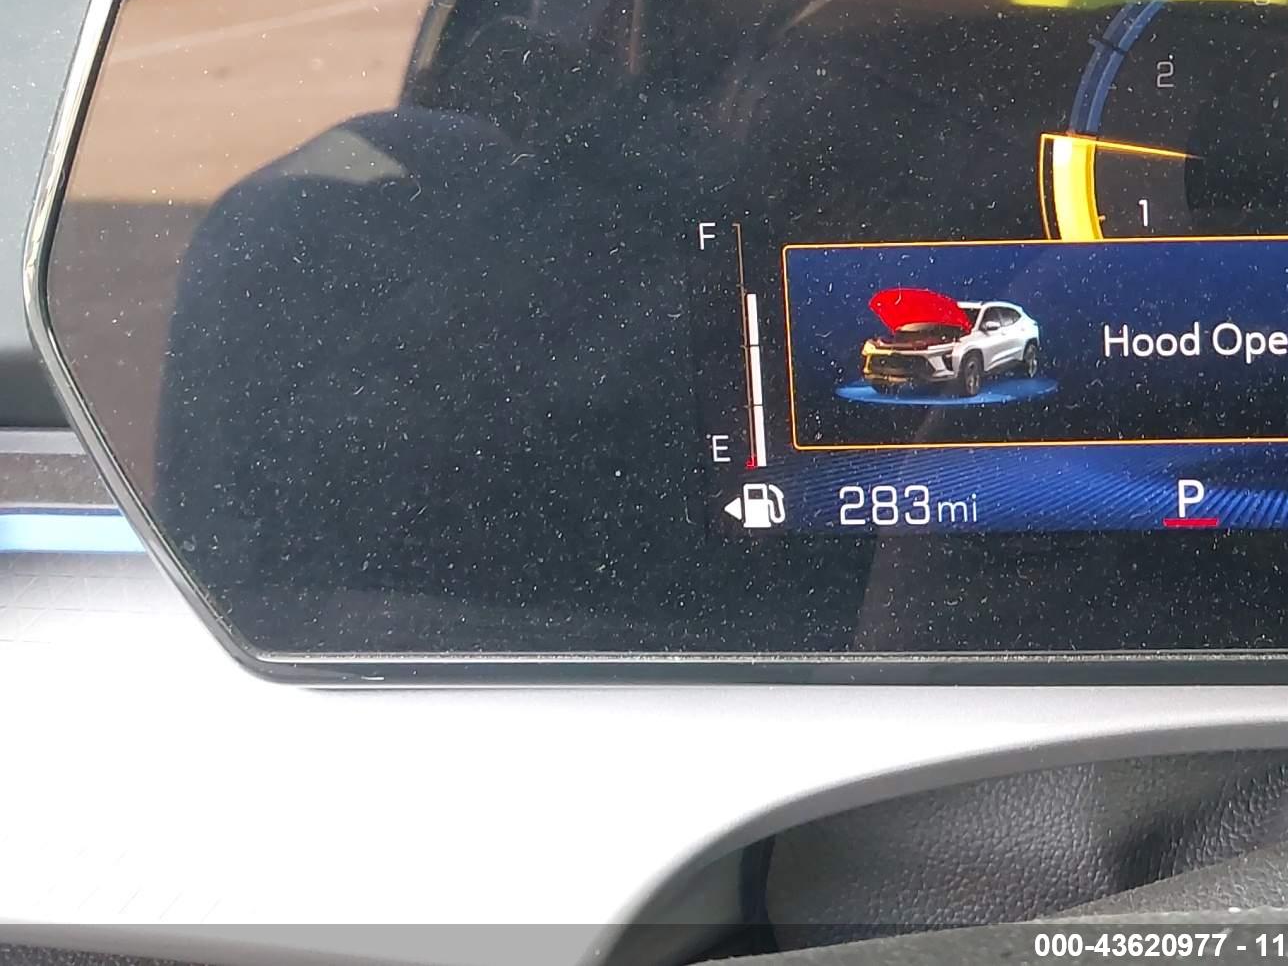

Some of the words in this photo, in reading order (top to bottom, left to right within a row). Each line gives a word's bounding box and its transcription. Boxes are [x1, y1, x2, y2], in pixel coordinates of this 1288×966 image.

[1156, 60, 1175, 89] 2
[1138, 199, 1149, 227] 1
[698, 222, 717, 251] F
[1104, 322, 1200, 358] Hood
[712, 435, 731, 463] E
[1178, 480, 1206, 518] P
